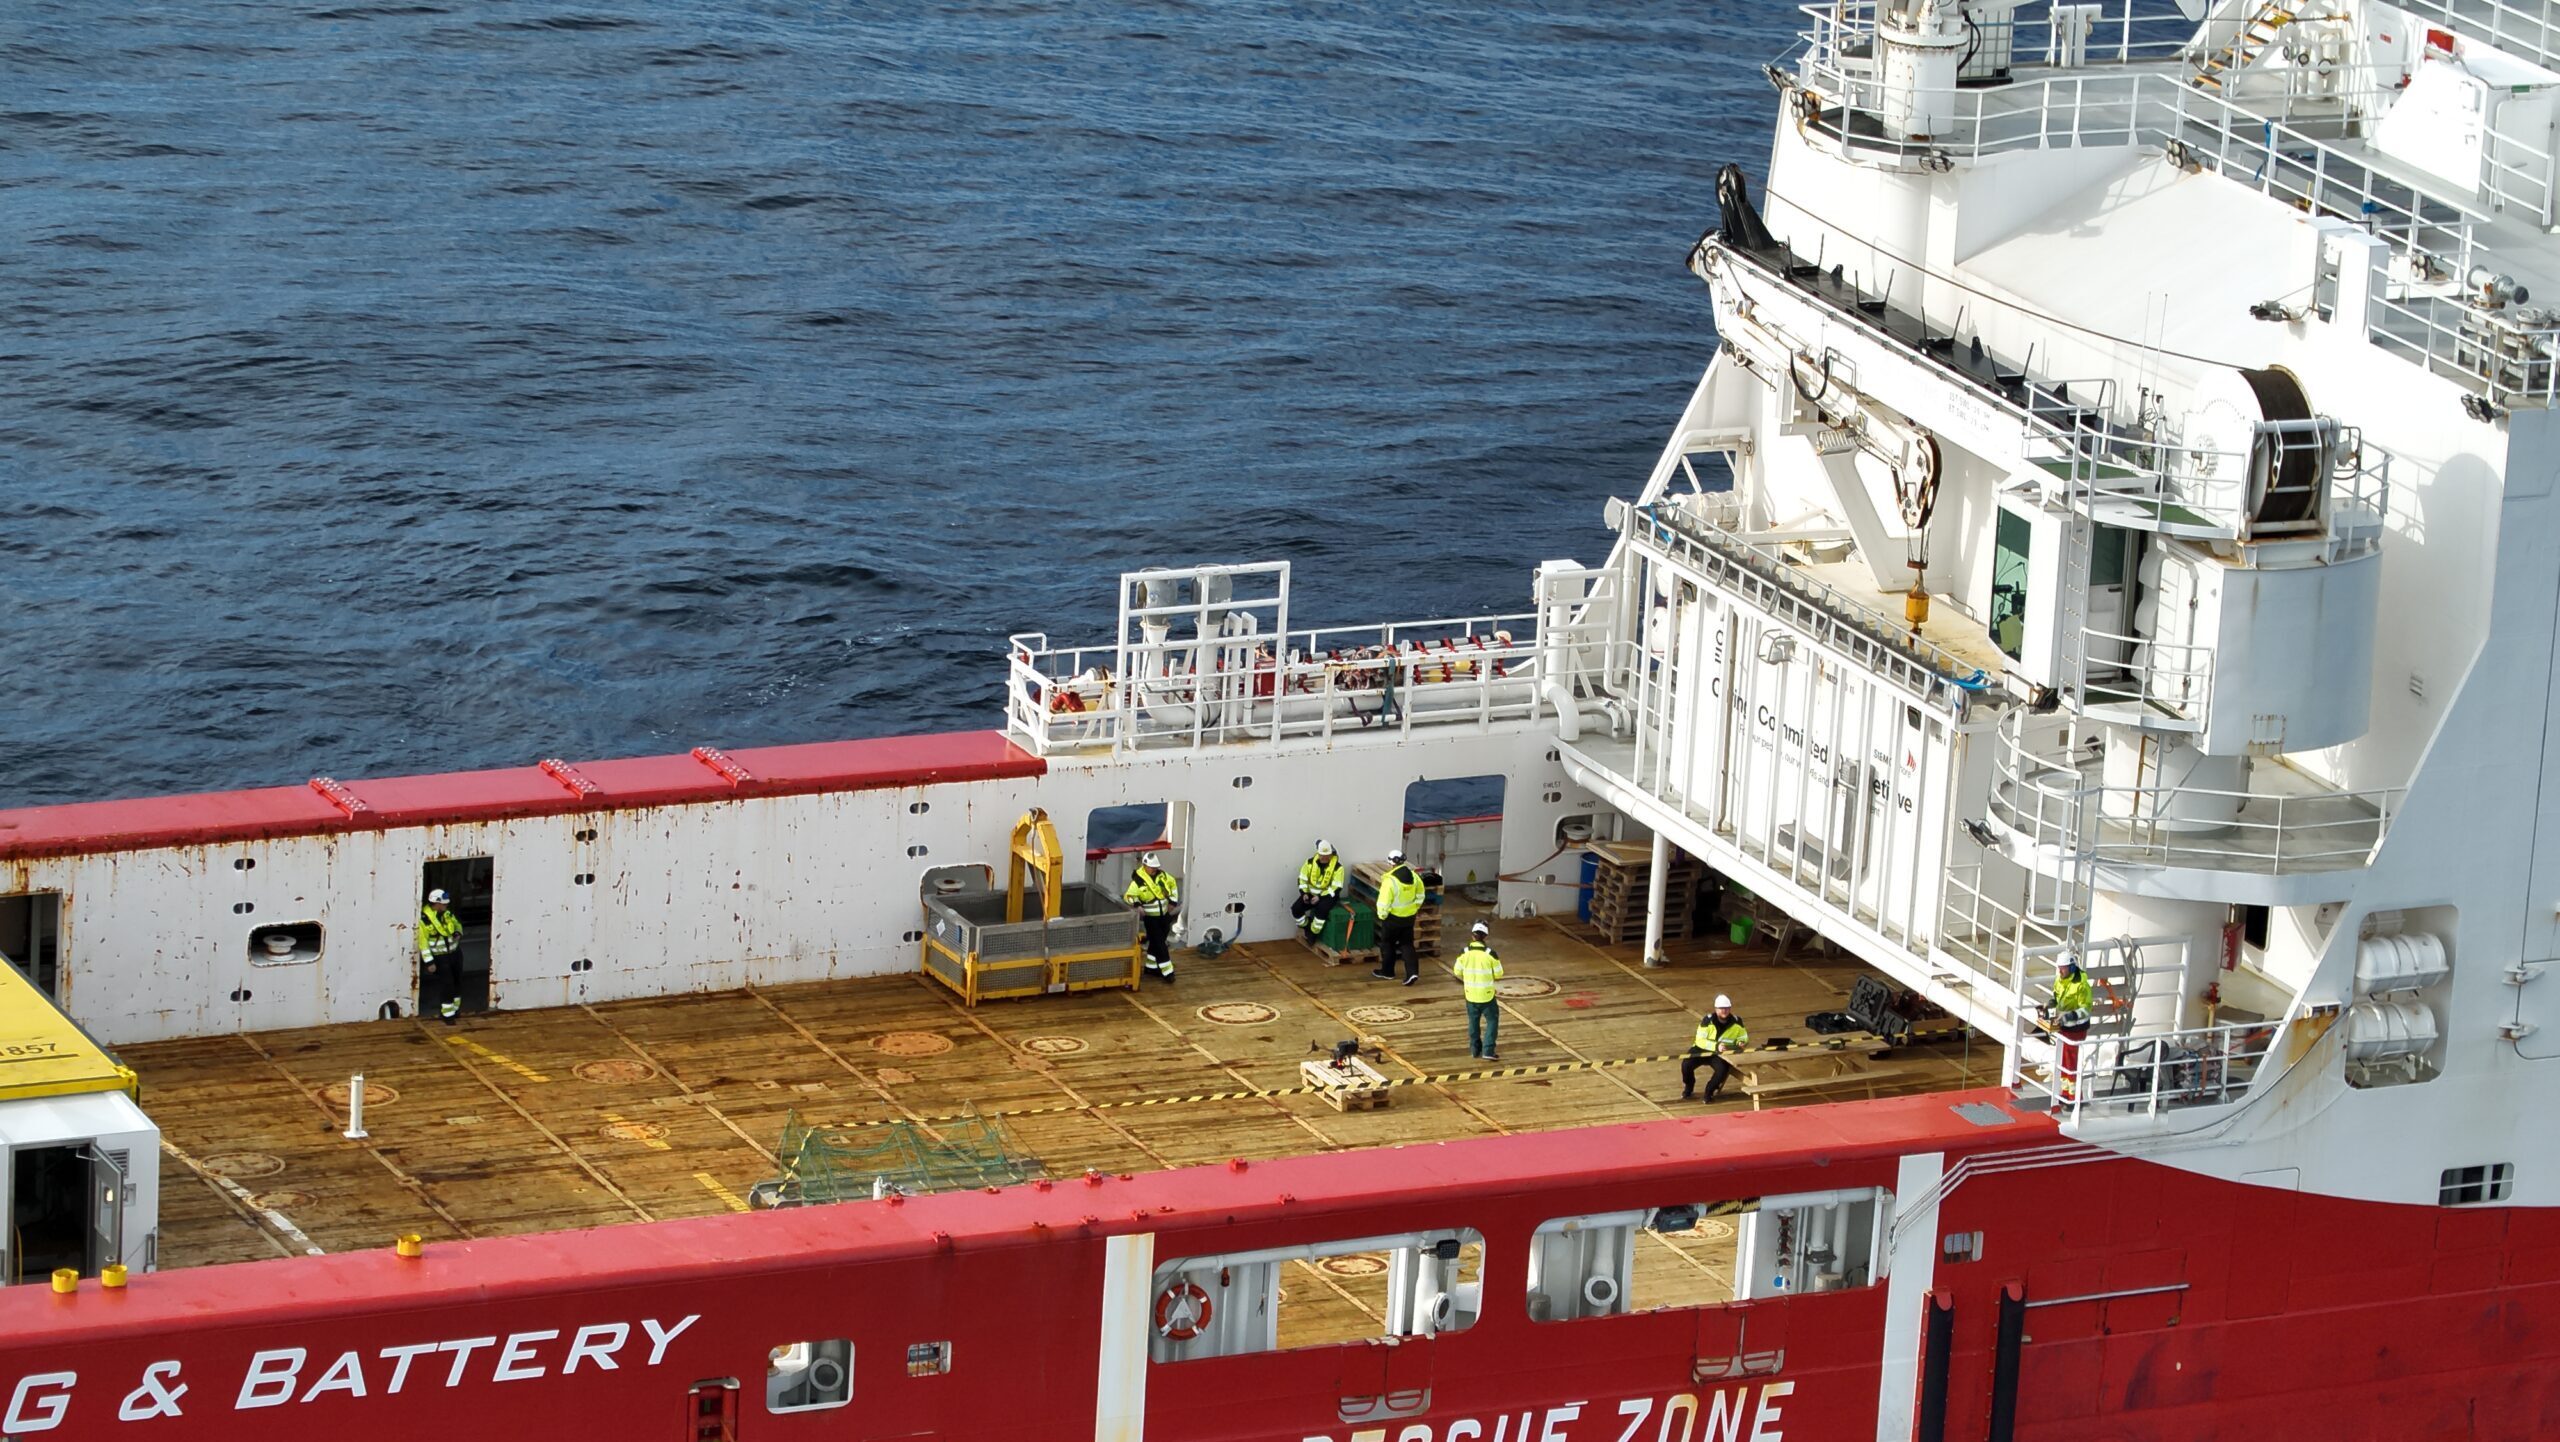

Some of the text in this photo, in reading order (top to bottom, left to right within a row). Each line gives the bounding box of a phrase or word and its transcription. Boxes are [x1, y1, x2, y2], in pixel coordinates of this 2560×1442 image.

[1758, 704, 1828, 765] Comied
[118, 1360, 189, 1422] &
[235, 1314, 701, 1410] BATTERY
[1616, 1381, 1796, 1442] ZONE
